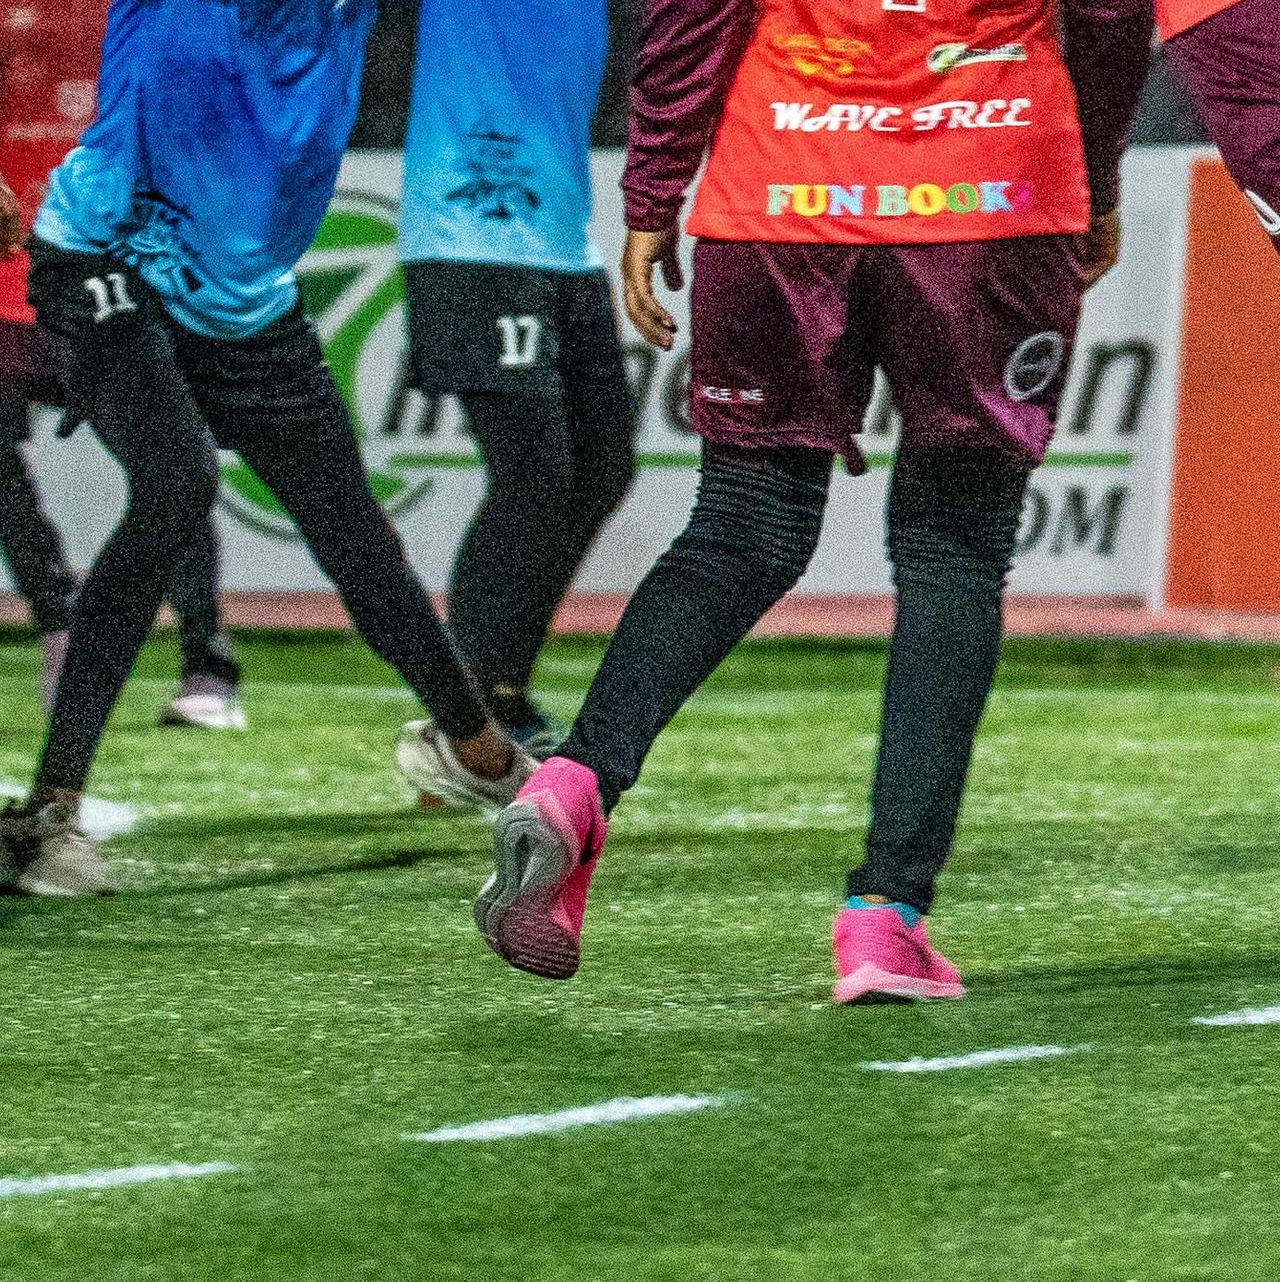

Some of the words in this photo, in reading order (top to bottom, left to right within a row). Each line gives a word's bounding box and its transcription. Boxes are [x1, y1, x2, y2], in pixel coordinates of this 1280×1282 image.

[769, 101, 903, 132] WAVE
[910, 98, 1031, 131] FREE
[767, 184, 864, 217] FUN
[83, 272, 136, 323] 11
[497, 315, 540, 367] 17
